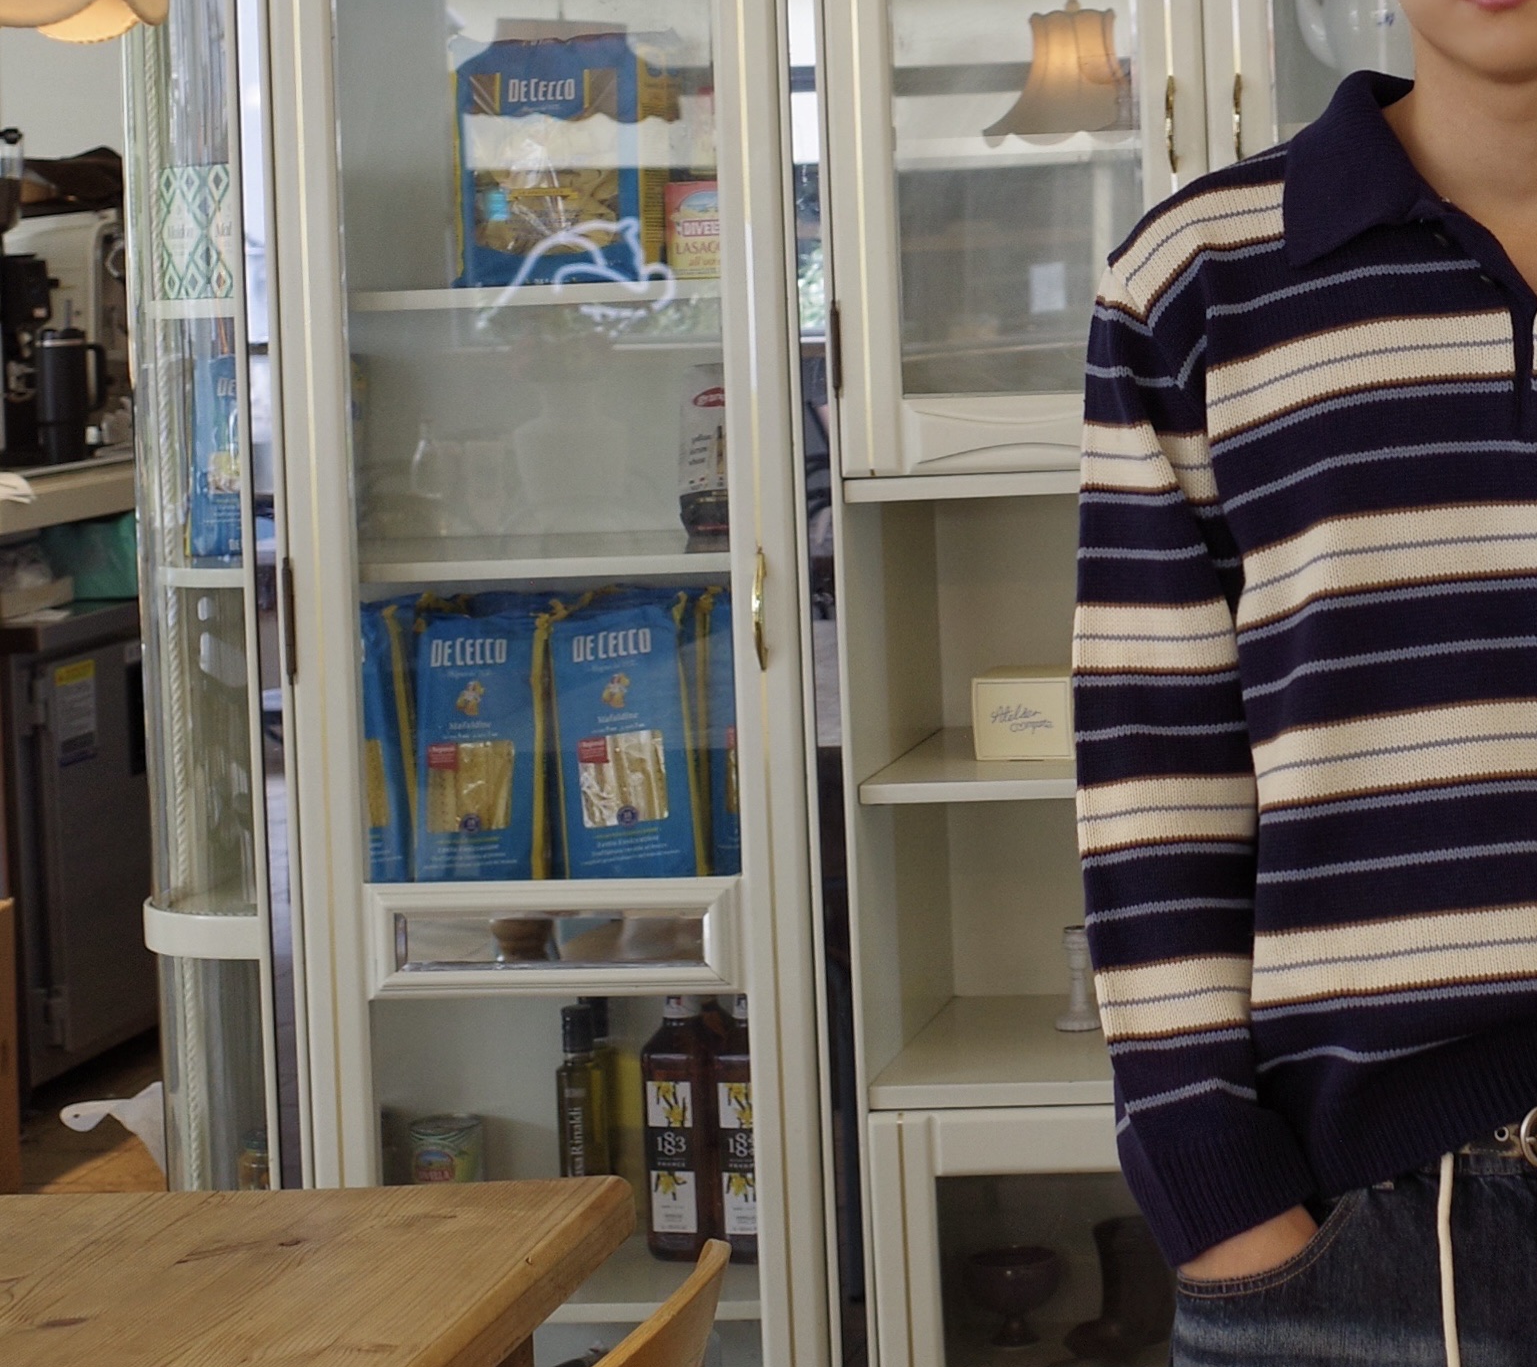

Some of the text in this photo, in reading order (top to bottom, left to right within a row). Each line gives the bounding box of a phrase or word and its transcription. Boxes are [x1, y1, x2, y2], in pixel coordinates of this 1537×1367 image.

[529, 77, 576, 102] CECCO
[455, 637, 508, 667] CECCO
[597, 627, 652, 660] CECCO
